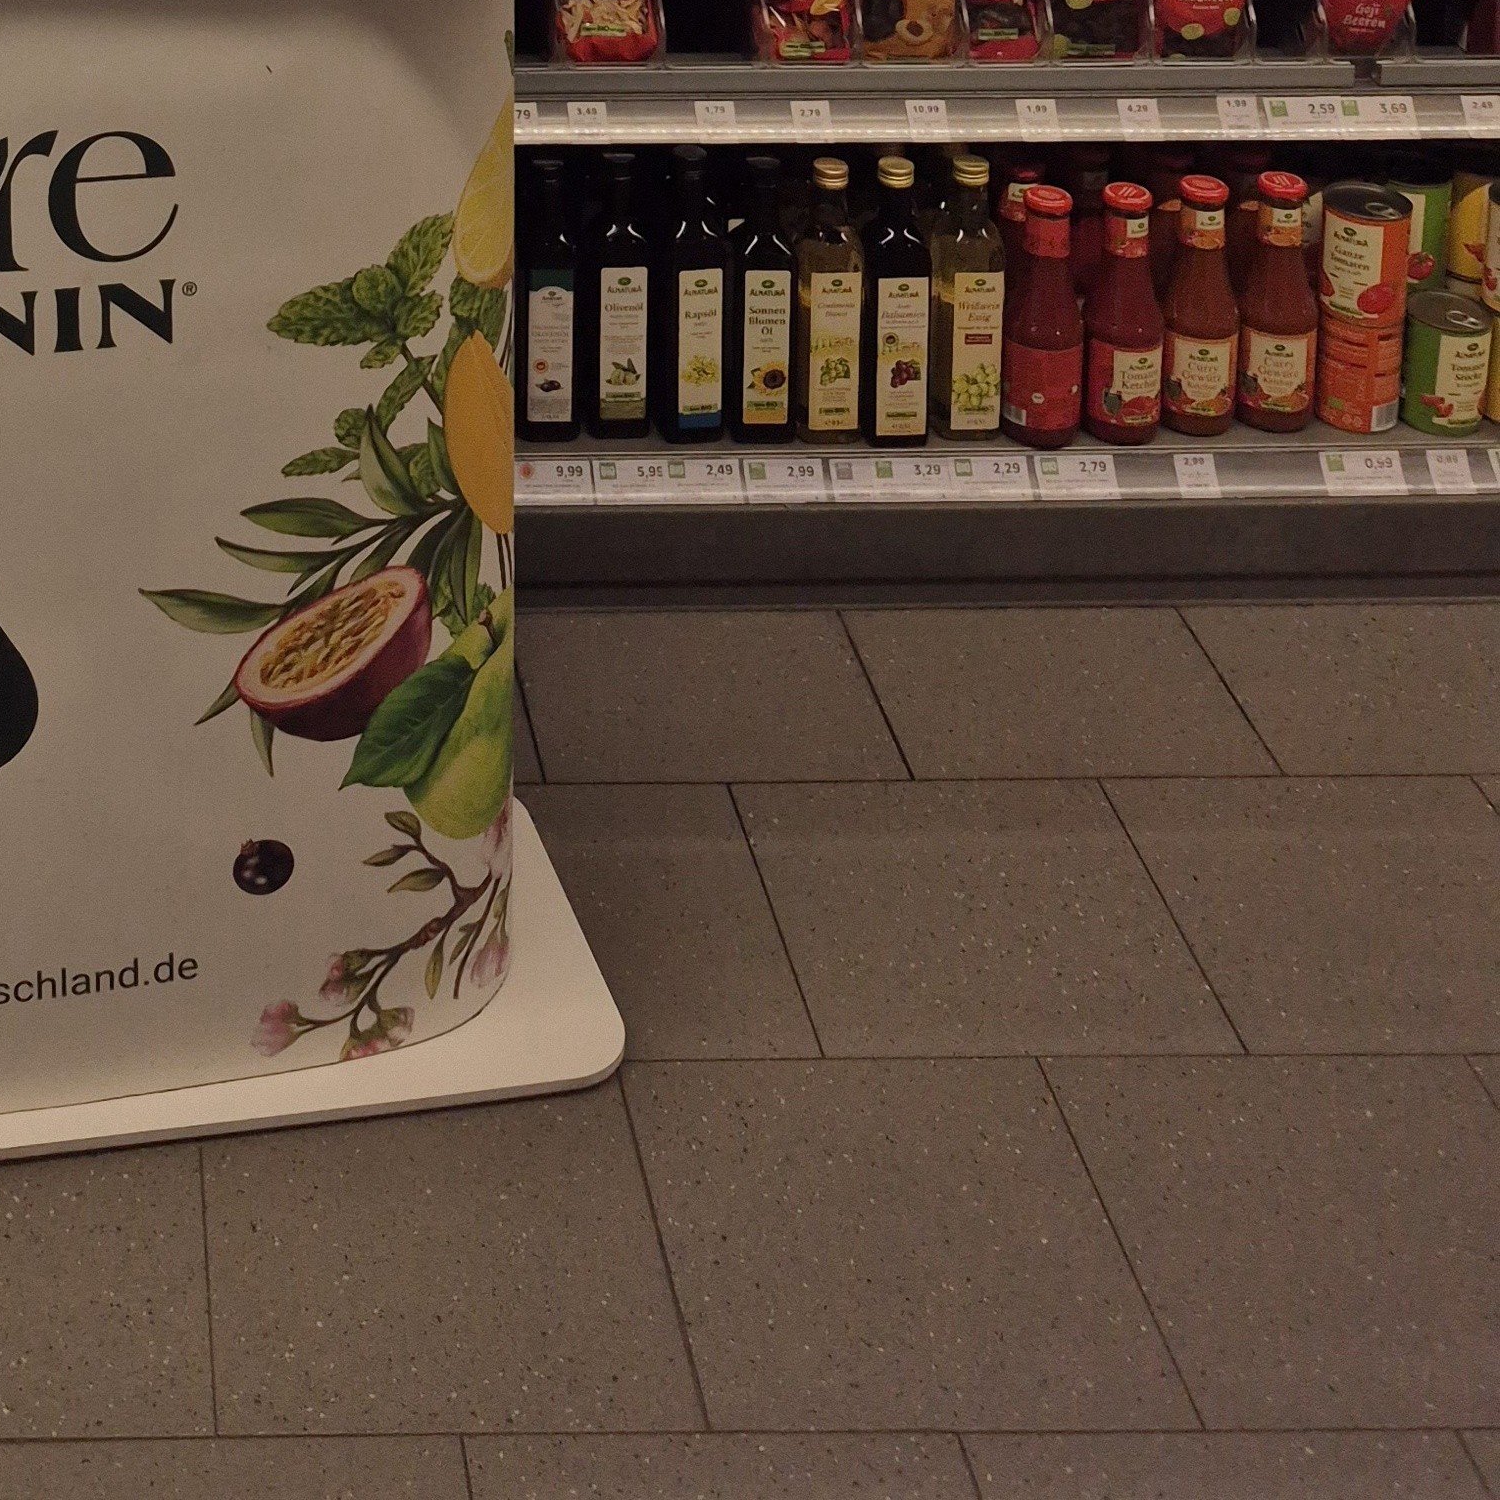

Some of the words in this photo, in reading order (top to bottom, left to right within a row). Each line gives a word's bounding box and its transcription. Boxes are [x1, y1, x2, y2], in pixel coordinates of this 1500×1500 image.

[1308, 103, 1335, 115] 2,59
[1379, 102, 1407, 114] 3,69
[605, 303, 644, 313] Olivenöl
[749, 305, 786, 315] Sonnen
[684, 309, 717, 321] Rapsöl
[748, 316, 786, 325] Blumen
[556, 465, 583, 478] 9,99
[637, 465, 663, 477] 5,99
[706, 464, 733, 476] 2,49
[786, 465, 814, 478] 2,99
[913, 464, 941, 476] 3,29
[993, 462, 1020, 474] 2,29
[1079, 460, 1107, 473] 2,79
